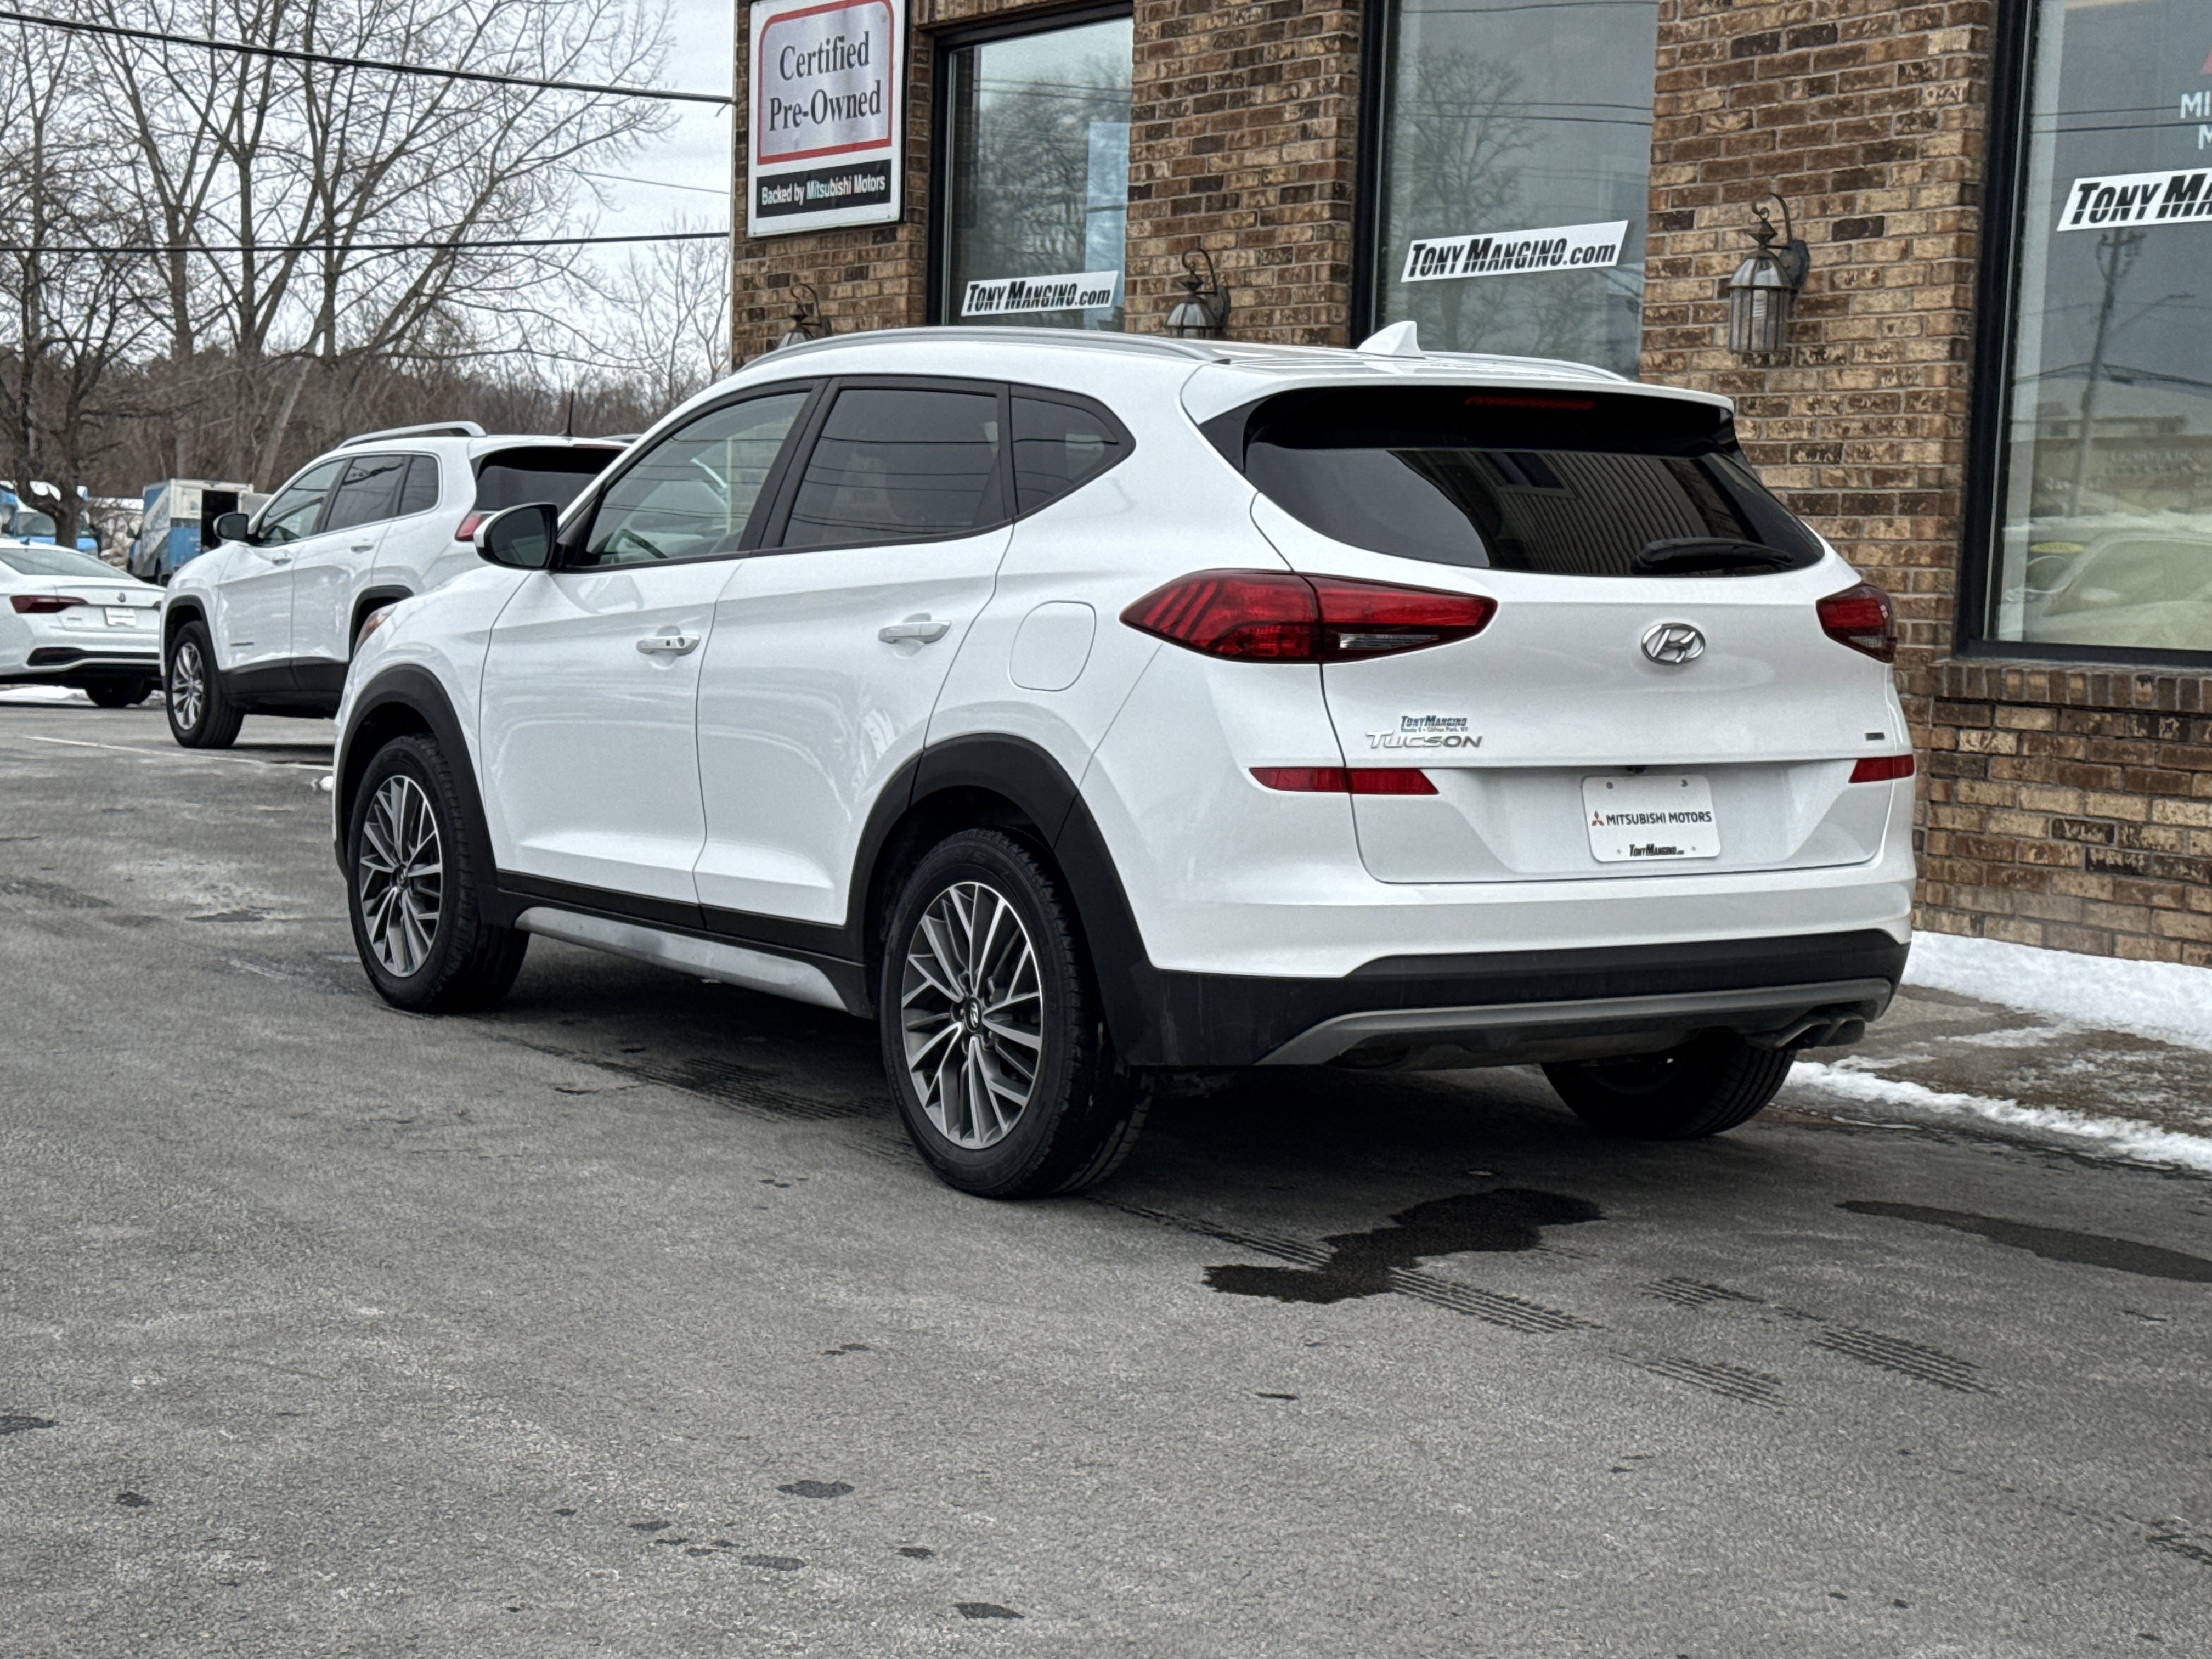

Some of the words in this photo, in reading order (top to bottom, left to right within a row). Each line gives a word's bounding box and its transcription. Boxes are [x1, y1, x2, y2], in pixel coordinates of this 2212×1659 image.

[780, 31, 870, 81] Certified
[769, 80, 881, 131] Pre-Owned
[761, 183, 792, 206] Backed
[794, 183, 805, 206] by
[806, 174, 852, 200] Mitsubishi
[854, 173, 886, 194] Motors
[2070, 182, 2163, 225] TONY
[1366, 730, 1483, 749] TUCSON
[1606, 812, 1667, 826] MITSUBISHI
[1668, 810, 1712, 824] MOTORS
